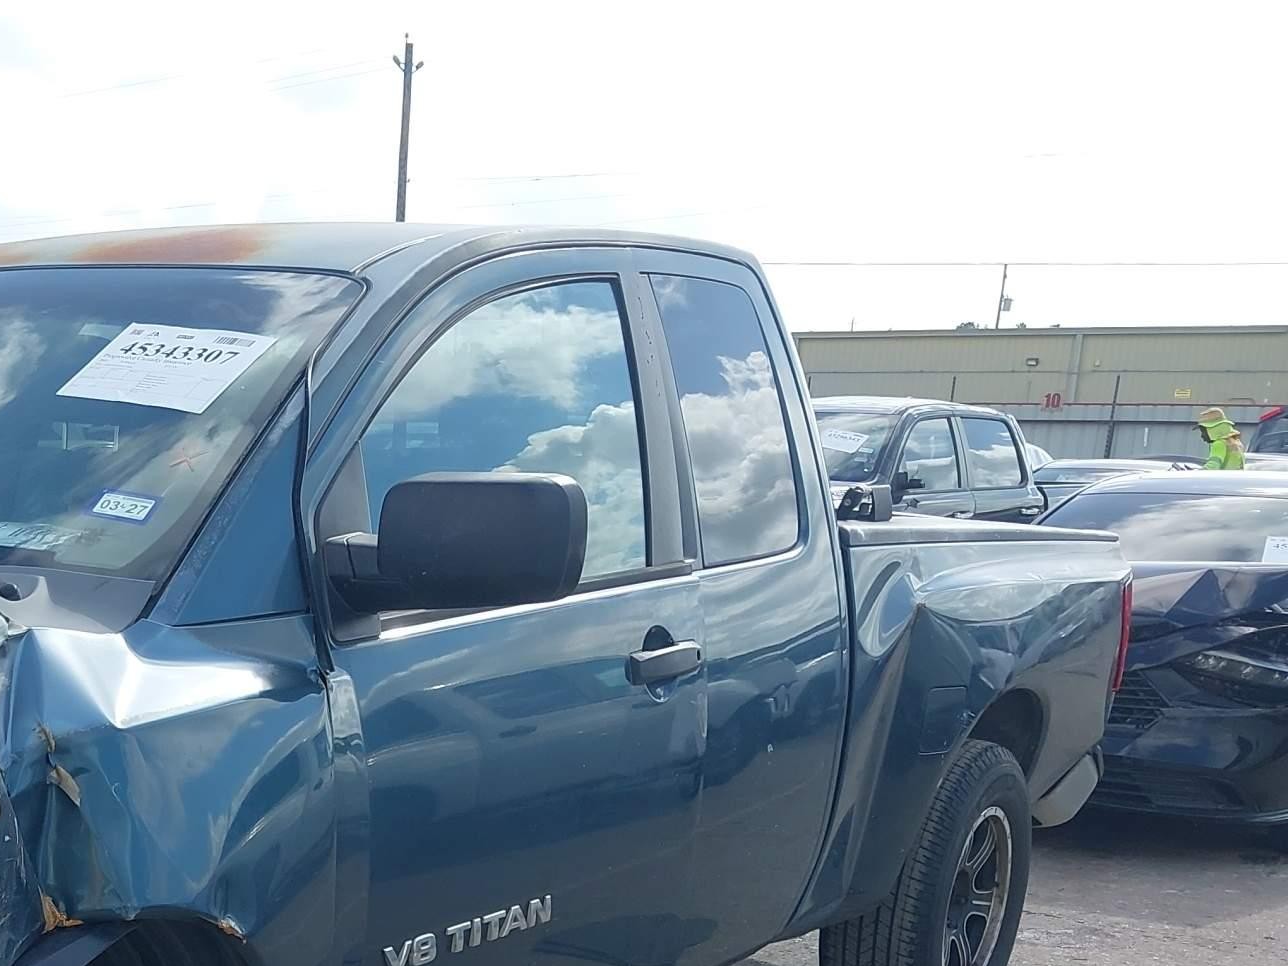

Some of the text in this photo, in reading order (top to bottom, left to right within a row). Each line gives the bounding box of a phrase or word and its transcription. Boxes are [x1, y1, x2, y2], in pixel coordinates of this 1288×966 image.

[119, 341, 241, 365] 45343307
[1044, 392, 1062, 409] 10
[445, 894, 552, 953] TITAN
